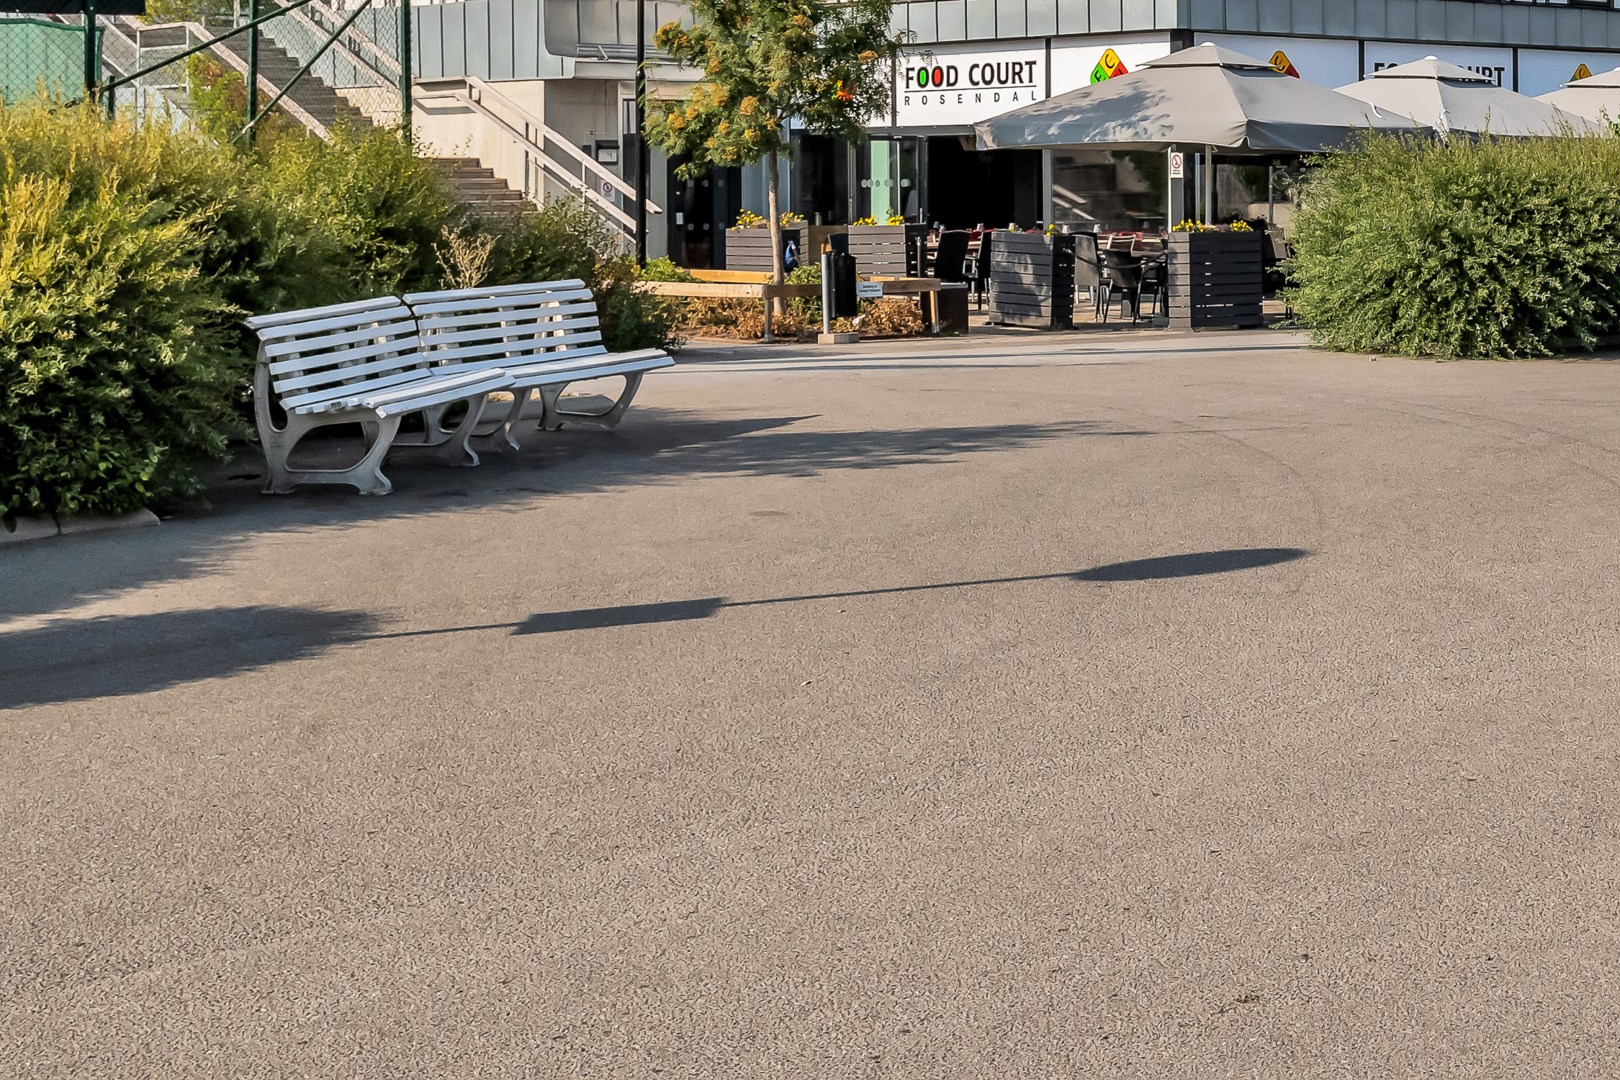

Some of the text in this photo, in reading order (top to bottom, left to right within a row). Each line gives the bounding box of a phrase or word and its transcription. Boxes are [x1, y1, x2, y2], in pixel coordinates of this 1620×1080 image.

[905, 60, 1037, 89] FOOD COURT
[904, 91, 1037, 106] ROSENDAL
